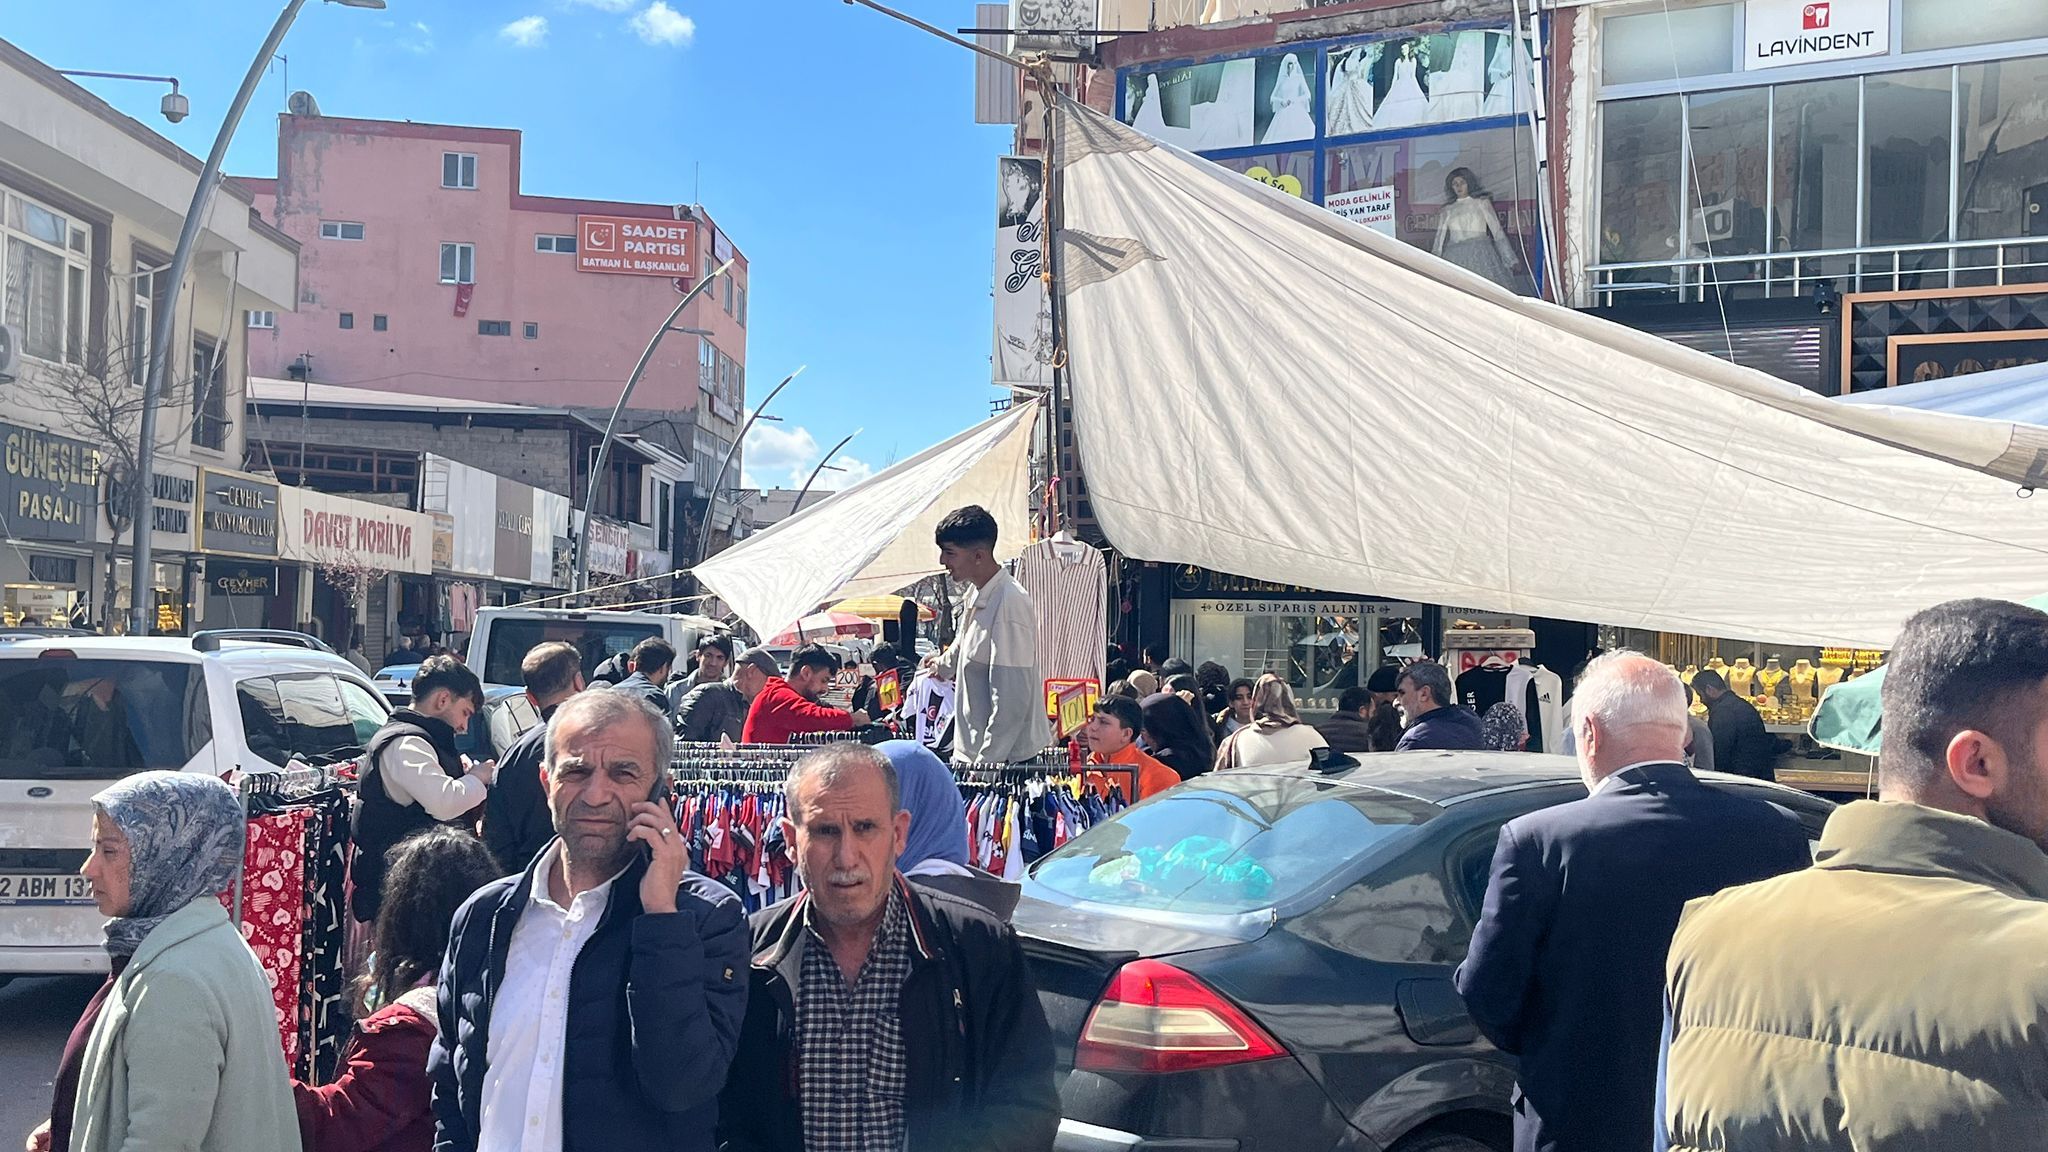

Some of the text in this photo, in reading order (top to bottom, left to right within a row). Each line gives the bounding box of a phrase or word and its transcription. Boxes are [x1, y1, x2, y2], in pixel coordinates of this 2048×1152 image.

[1758, 30, 1874, 57] LAVİNDENT
[1328, 190, 1391, 208] MODA GELİNLİK
[1349, 206, 1365, 216] YAN
[1366, 202, 1391, 212] TARAF
[622, 224, 688, 240] SAADET
[624, 240, 686, 256] PARTİSİ
[582, 257, 689, 273] BATMAN İL BAŞKANLIĞI
[5, 429, 101, 492] GÜNEŞLER
[152, 473, 194, 504] YUMCU
[228, 486, 263, 509] CEVHER
[18, 490, 80, 525] PASAJI
[152, 505, 190, 534] AHMUT
[214, 511, 275, 537] KUYUMCULUK
[356, 514, 412, 561] MOBİLYA
[1215, 600, 1376, 615] ÖZEL SİPARİŞ ALINIR
[17, 877, 56, 897] ABM
